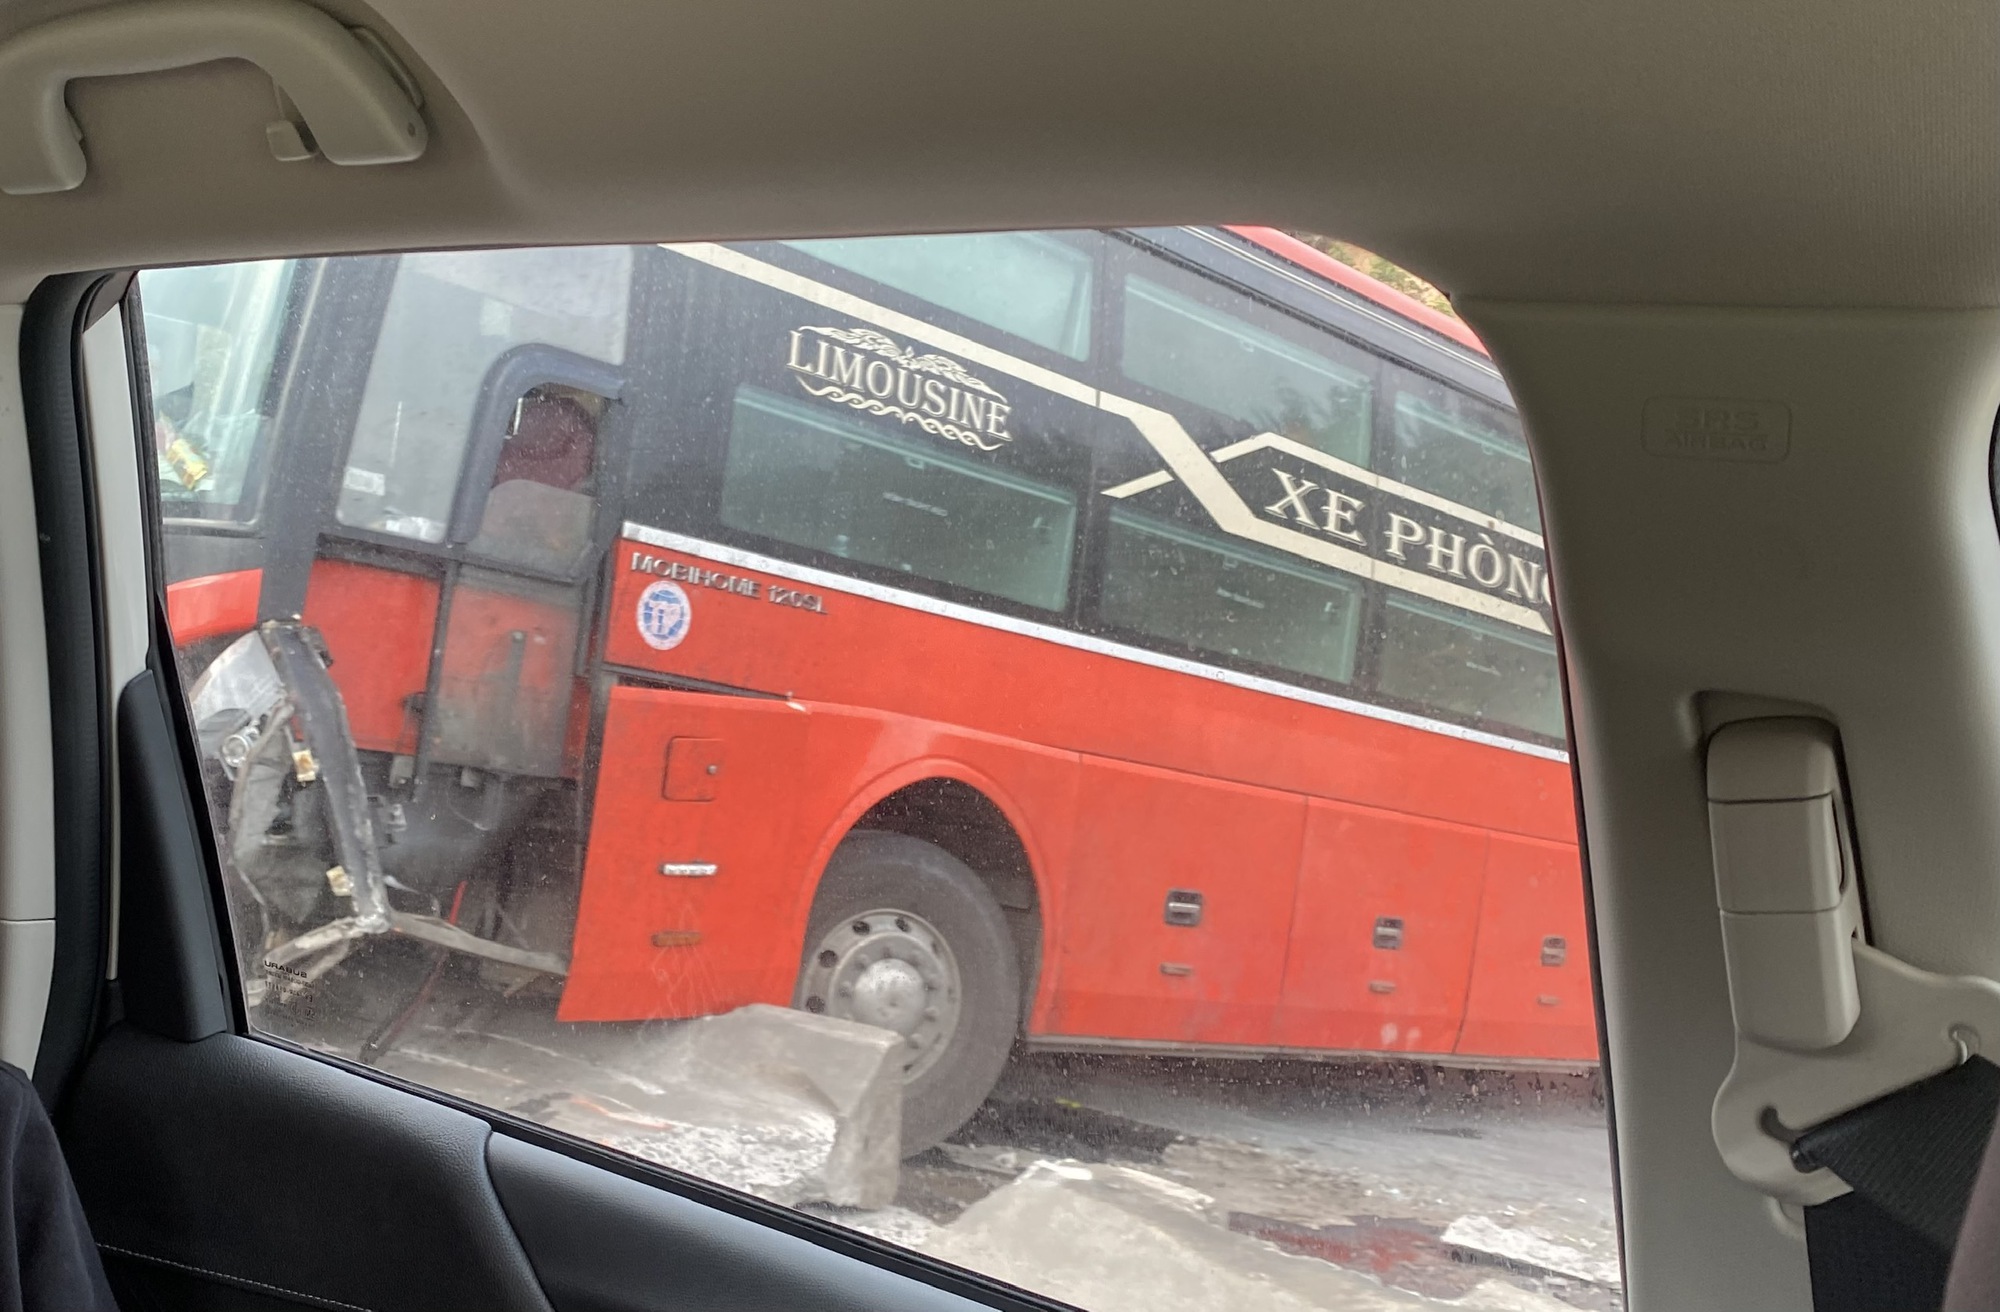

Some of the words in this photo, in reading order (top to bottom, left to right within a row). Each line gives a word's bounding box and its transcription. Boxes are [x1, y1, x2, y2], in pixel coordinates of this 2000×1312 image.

[786, 330, 1013, 442] LIMOUSINE
[1265, 467, 1368, 547] XE
[631, 551, 762, 599] MOBIHOME
[766, 584, 829, 615] 120SL
